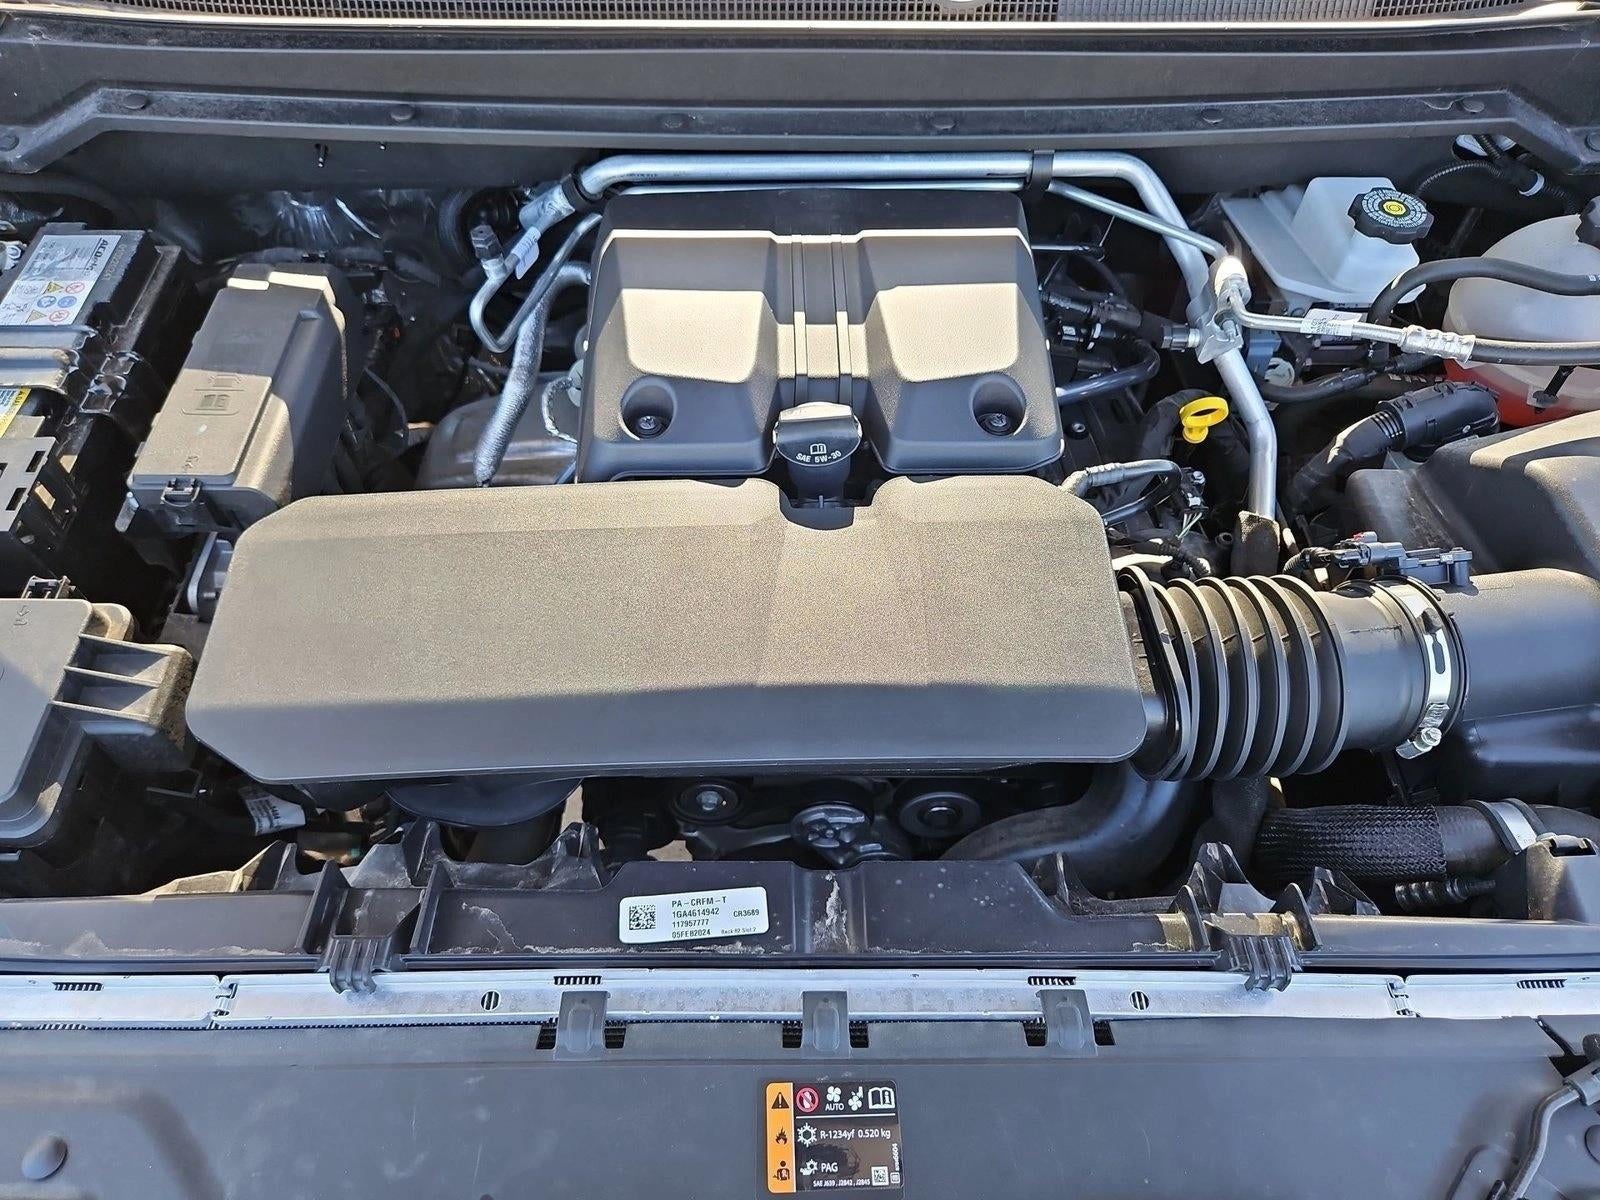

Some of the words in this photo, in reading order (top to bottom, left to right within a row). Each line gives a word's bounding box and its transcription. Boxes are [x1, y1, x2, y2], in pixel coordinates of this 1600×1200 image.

[796, 453, 812, 463] SAE
[814, 450, 842, 463] 5W-30
[672, 908, 720, 918] 1GA4614942
[672, 919, 709, 928] 117957777
[672, 929, 711, 939] 05FEB2024
[825, 1102, 845, 1111] AUTO
[820, 1129, 856, 1141] R-1234yf
[857, 1128, 880, 1138] 0.520
[881, 1128, 891, 1139] kg
[821, 1162, 839, 1172] PAG
